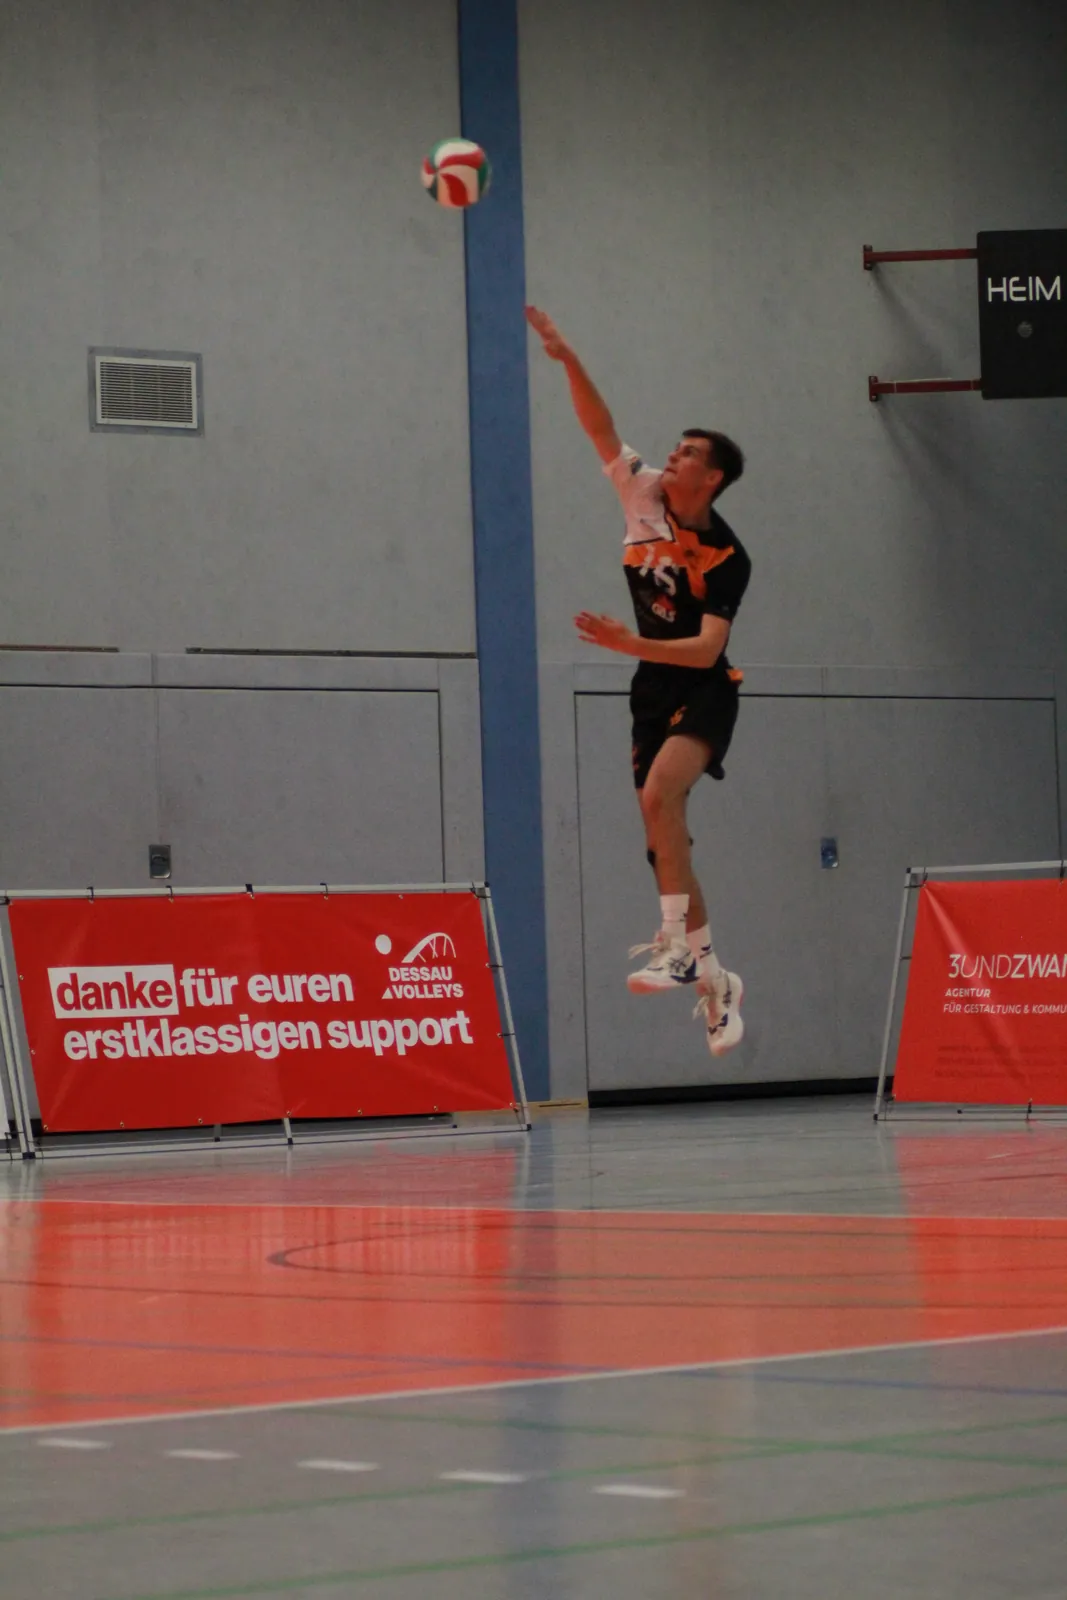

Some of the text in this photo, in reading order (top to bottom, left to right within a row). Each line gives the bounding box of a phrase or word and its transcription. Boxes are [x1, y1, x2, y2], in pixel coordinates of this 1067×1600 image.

[988, 275, 1061, 302] HEIM
[388, 966, 453, 982] DESSAU
[56, 968, 355, 1011] danke für euren
[392, 983, 464, 999] VOLLEYS
[945, 987, 991, 998] AGENTUR
[943, 1002, 962, 1013] FÜR
[964, 1003, 1021, 1014] GESTALTUNG
[1023, 1004, 1030, 1014] &
[64, 1010, 474, 1061] erstklassigen support
